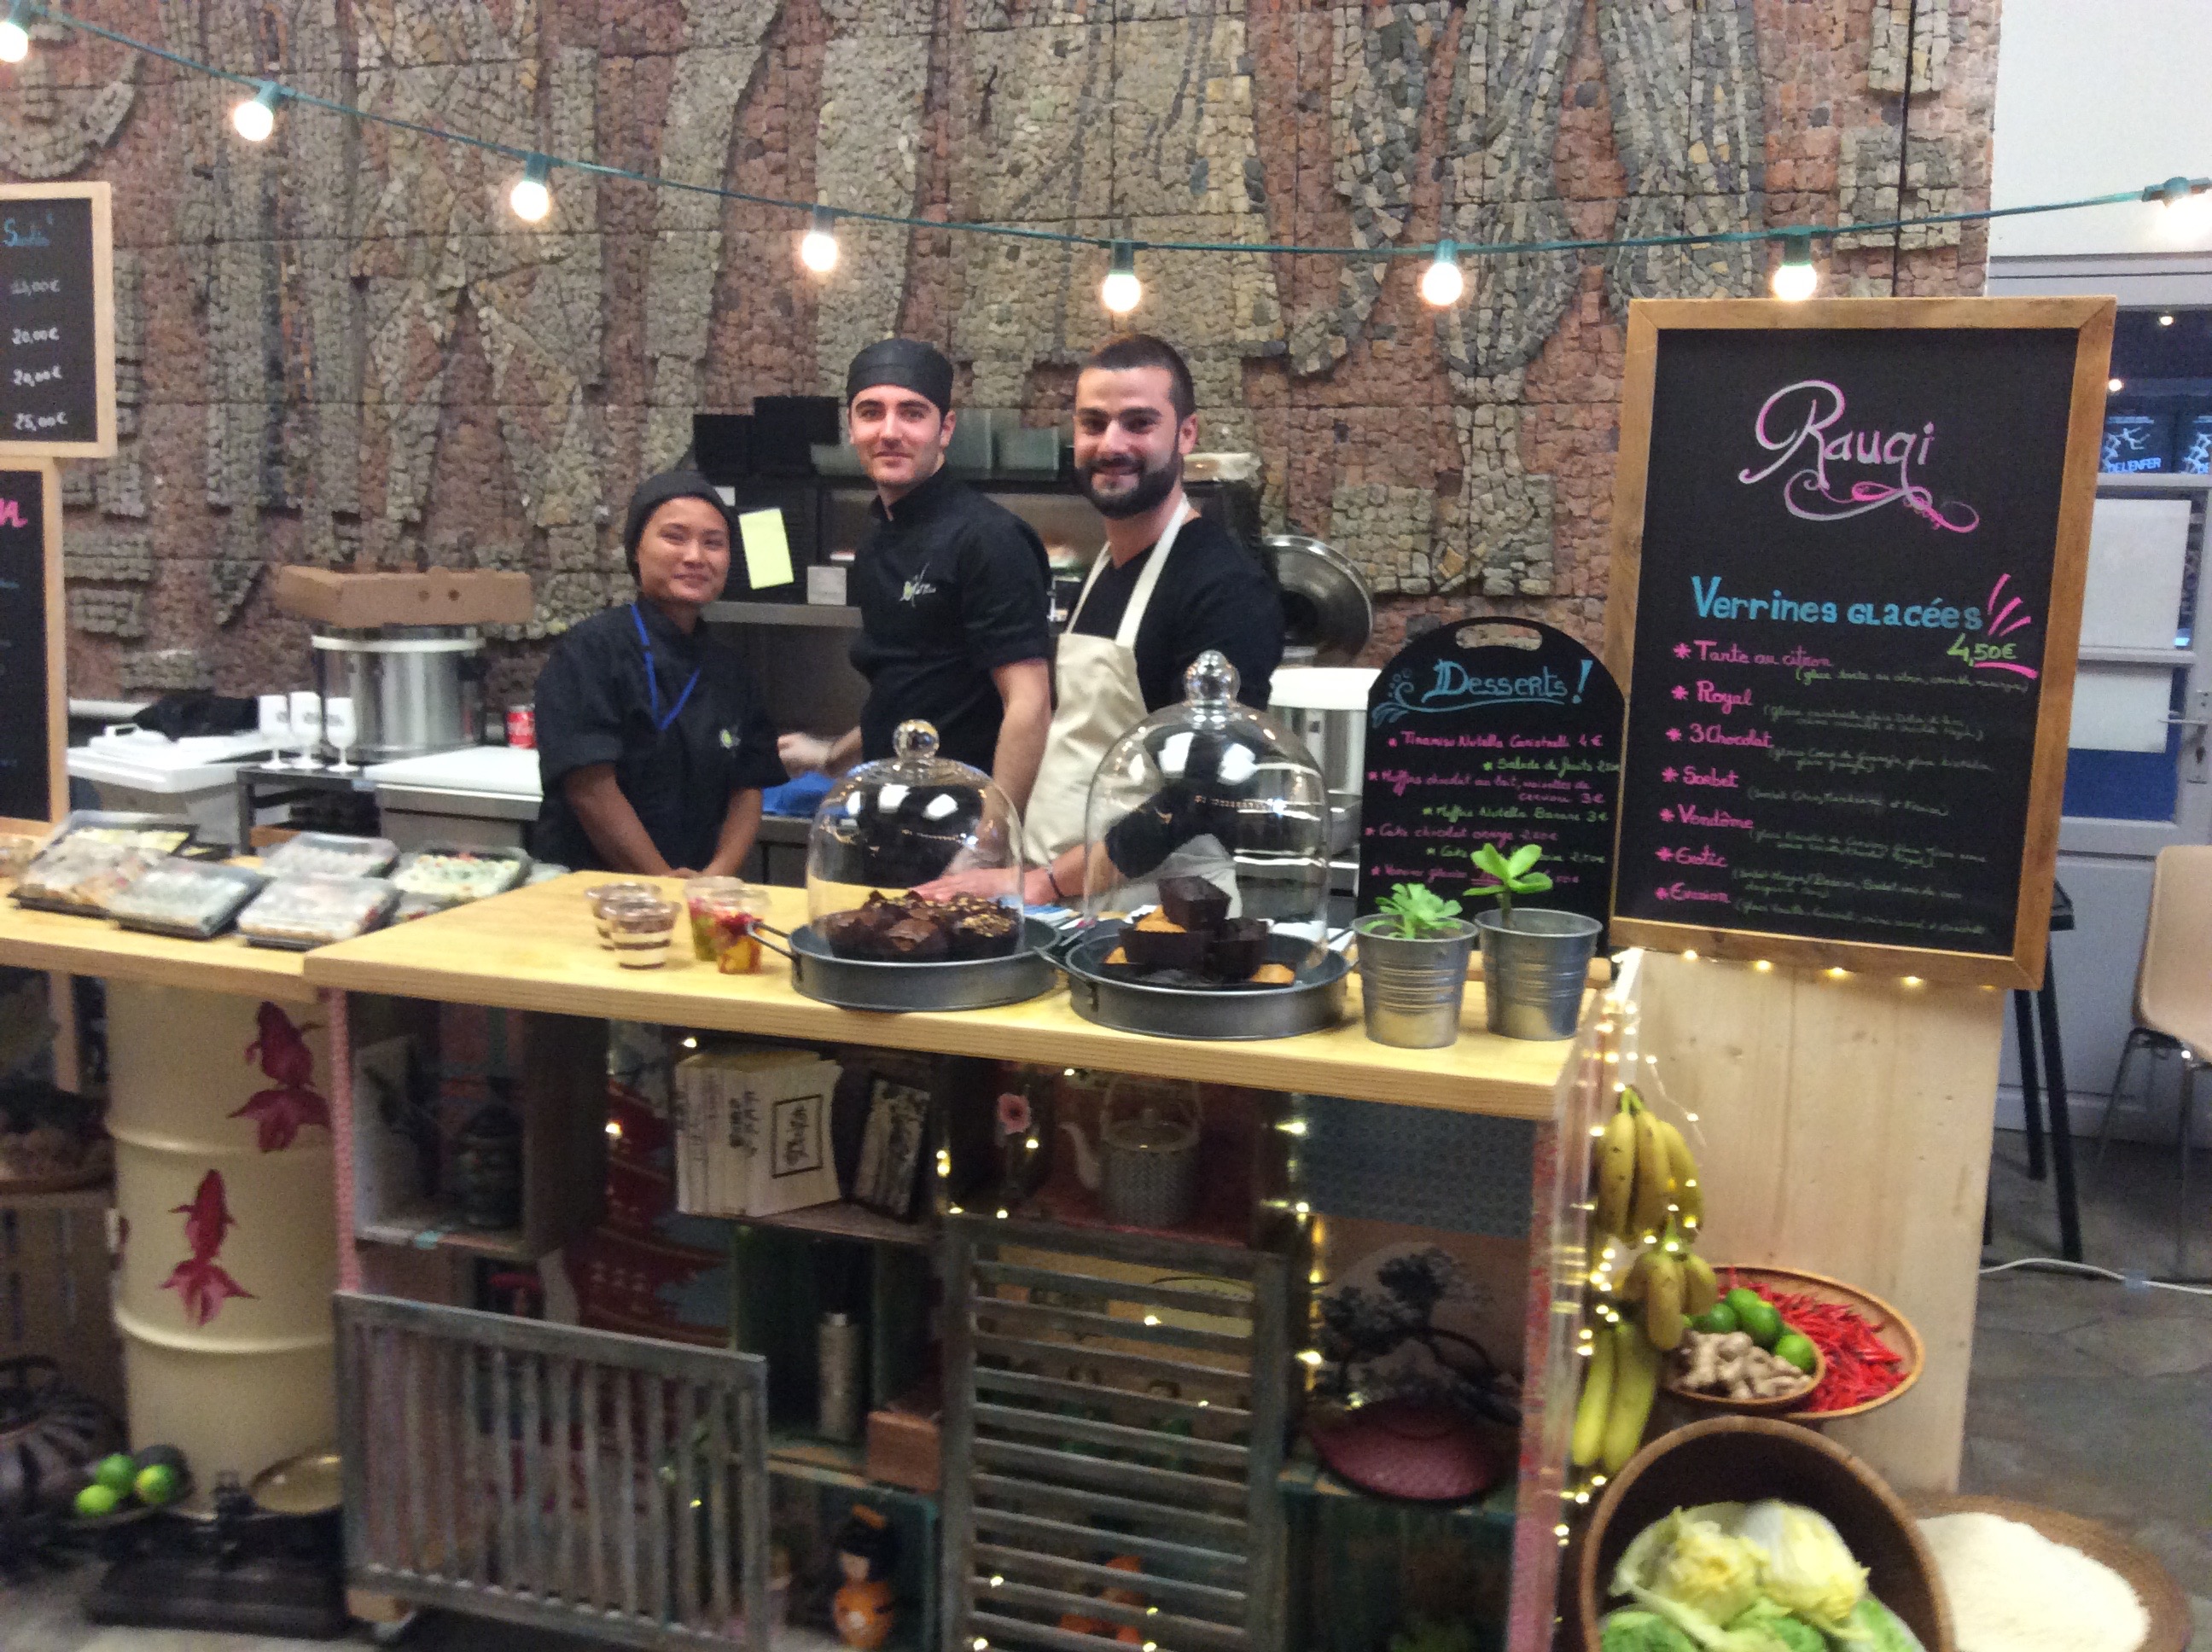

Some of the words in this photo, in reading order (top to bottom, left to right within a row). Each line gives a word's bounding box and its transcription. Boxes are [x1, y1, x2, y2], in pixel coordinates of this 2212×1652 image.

[1690, 575, 1837, 623] Verrines
[1693, 639, 1750, 664] Tarte
[1754, 653, 1780, 666] au
[1781, 645, 1835, 667] citron
[1946, 632, 2017, 666] 4,50€
[1695, 679, 1754, 715] Royal
[1681, 765, 1740, 788] Sorbet
[1677, 803, 1755, 829] Vendôme
